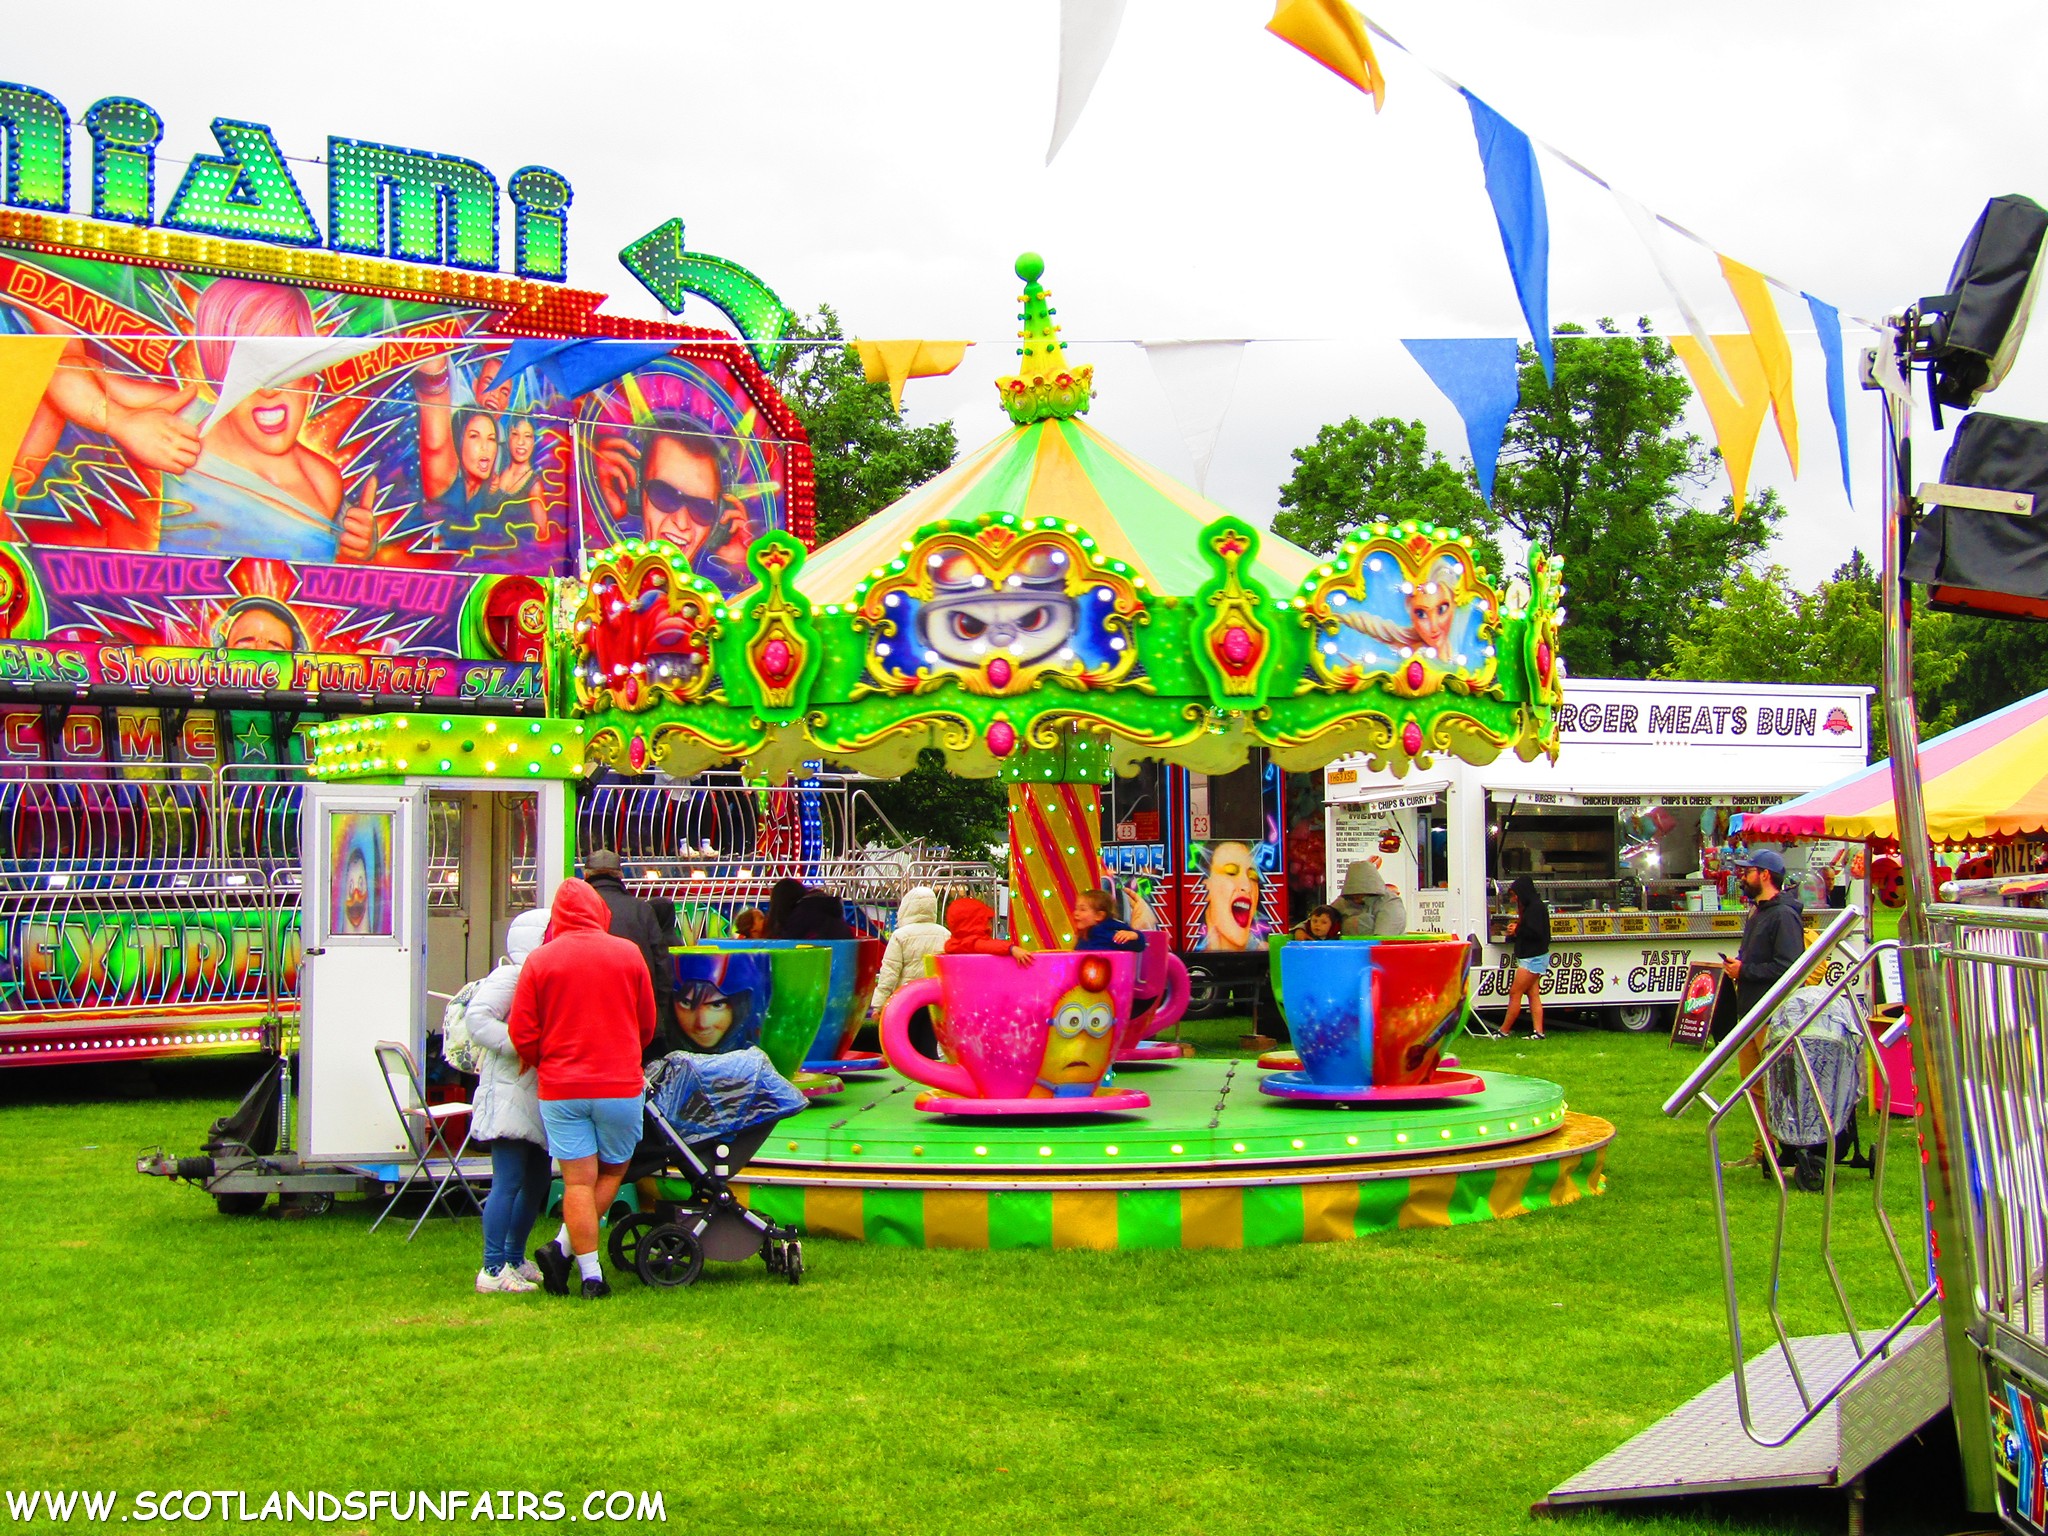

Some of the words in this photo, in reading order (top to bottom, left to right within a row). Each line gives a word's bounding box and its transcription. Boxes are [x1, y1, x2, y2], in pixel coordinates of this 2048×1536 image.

[7, 264, 172, 372] DANCE
[326, 318, 457, 394] CRAZY
[41, 552, 224, 594] MUZIC
[302, 568, 455, 613] MAFIA
[98, 646, 280, 690] Showtime
[460, 665, 543, 699] SLA
[1551, 703, 1638, 734] RGER
[1648, 705, 1747, 735] MEATS
[1756, 707, 1817, 736] BUN
[5, 712, 217, 759] COME
[1378, 801, 1398, 811] CHIPS
[1399, 799, 1405, 808] &
[1406, 795, 1428, 806] CURRY
[1535, 794, 1556, 804] BURGERS
[1582, 796, 1610, 806] CHICKEN
[1612, 796, 1641, 806] BURGERS
[1661, 796, 1680, 806] CHIPS
[1681, 796, 1688, 806] &
[1689, 796, 1712, 806] CHEESE
[1732, 796, 1759, 805] CHICKEN
[1760, 796, 1783, 805] WRAPS
[1122, 826, 1132, 838] £3
[1194, 817, 1208, 833] £3
[1103, 844, 1165, 879] HERE
[1641, 950, 1691, 965] TASTY
[1478, 967, 1604, 997] BUGERS
[1627, 966, 1688, 993] CHIP
